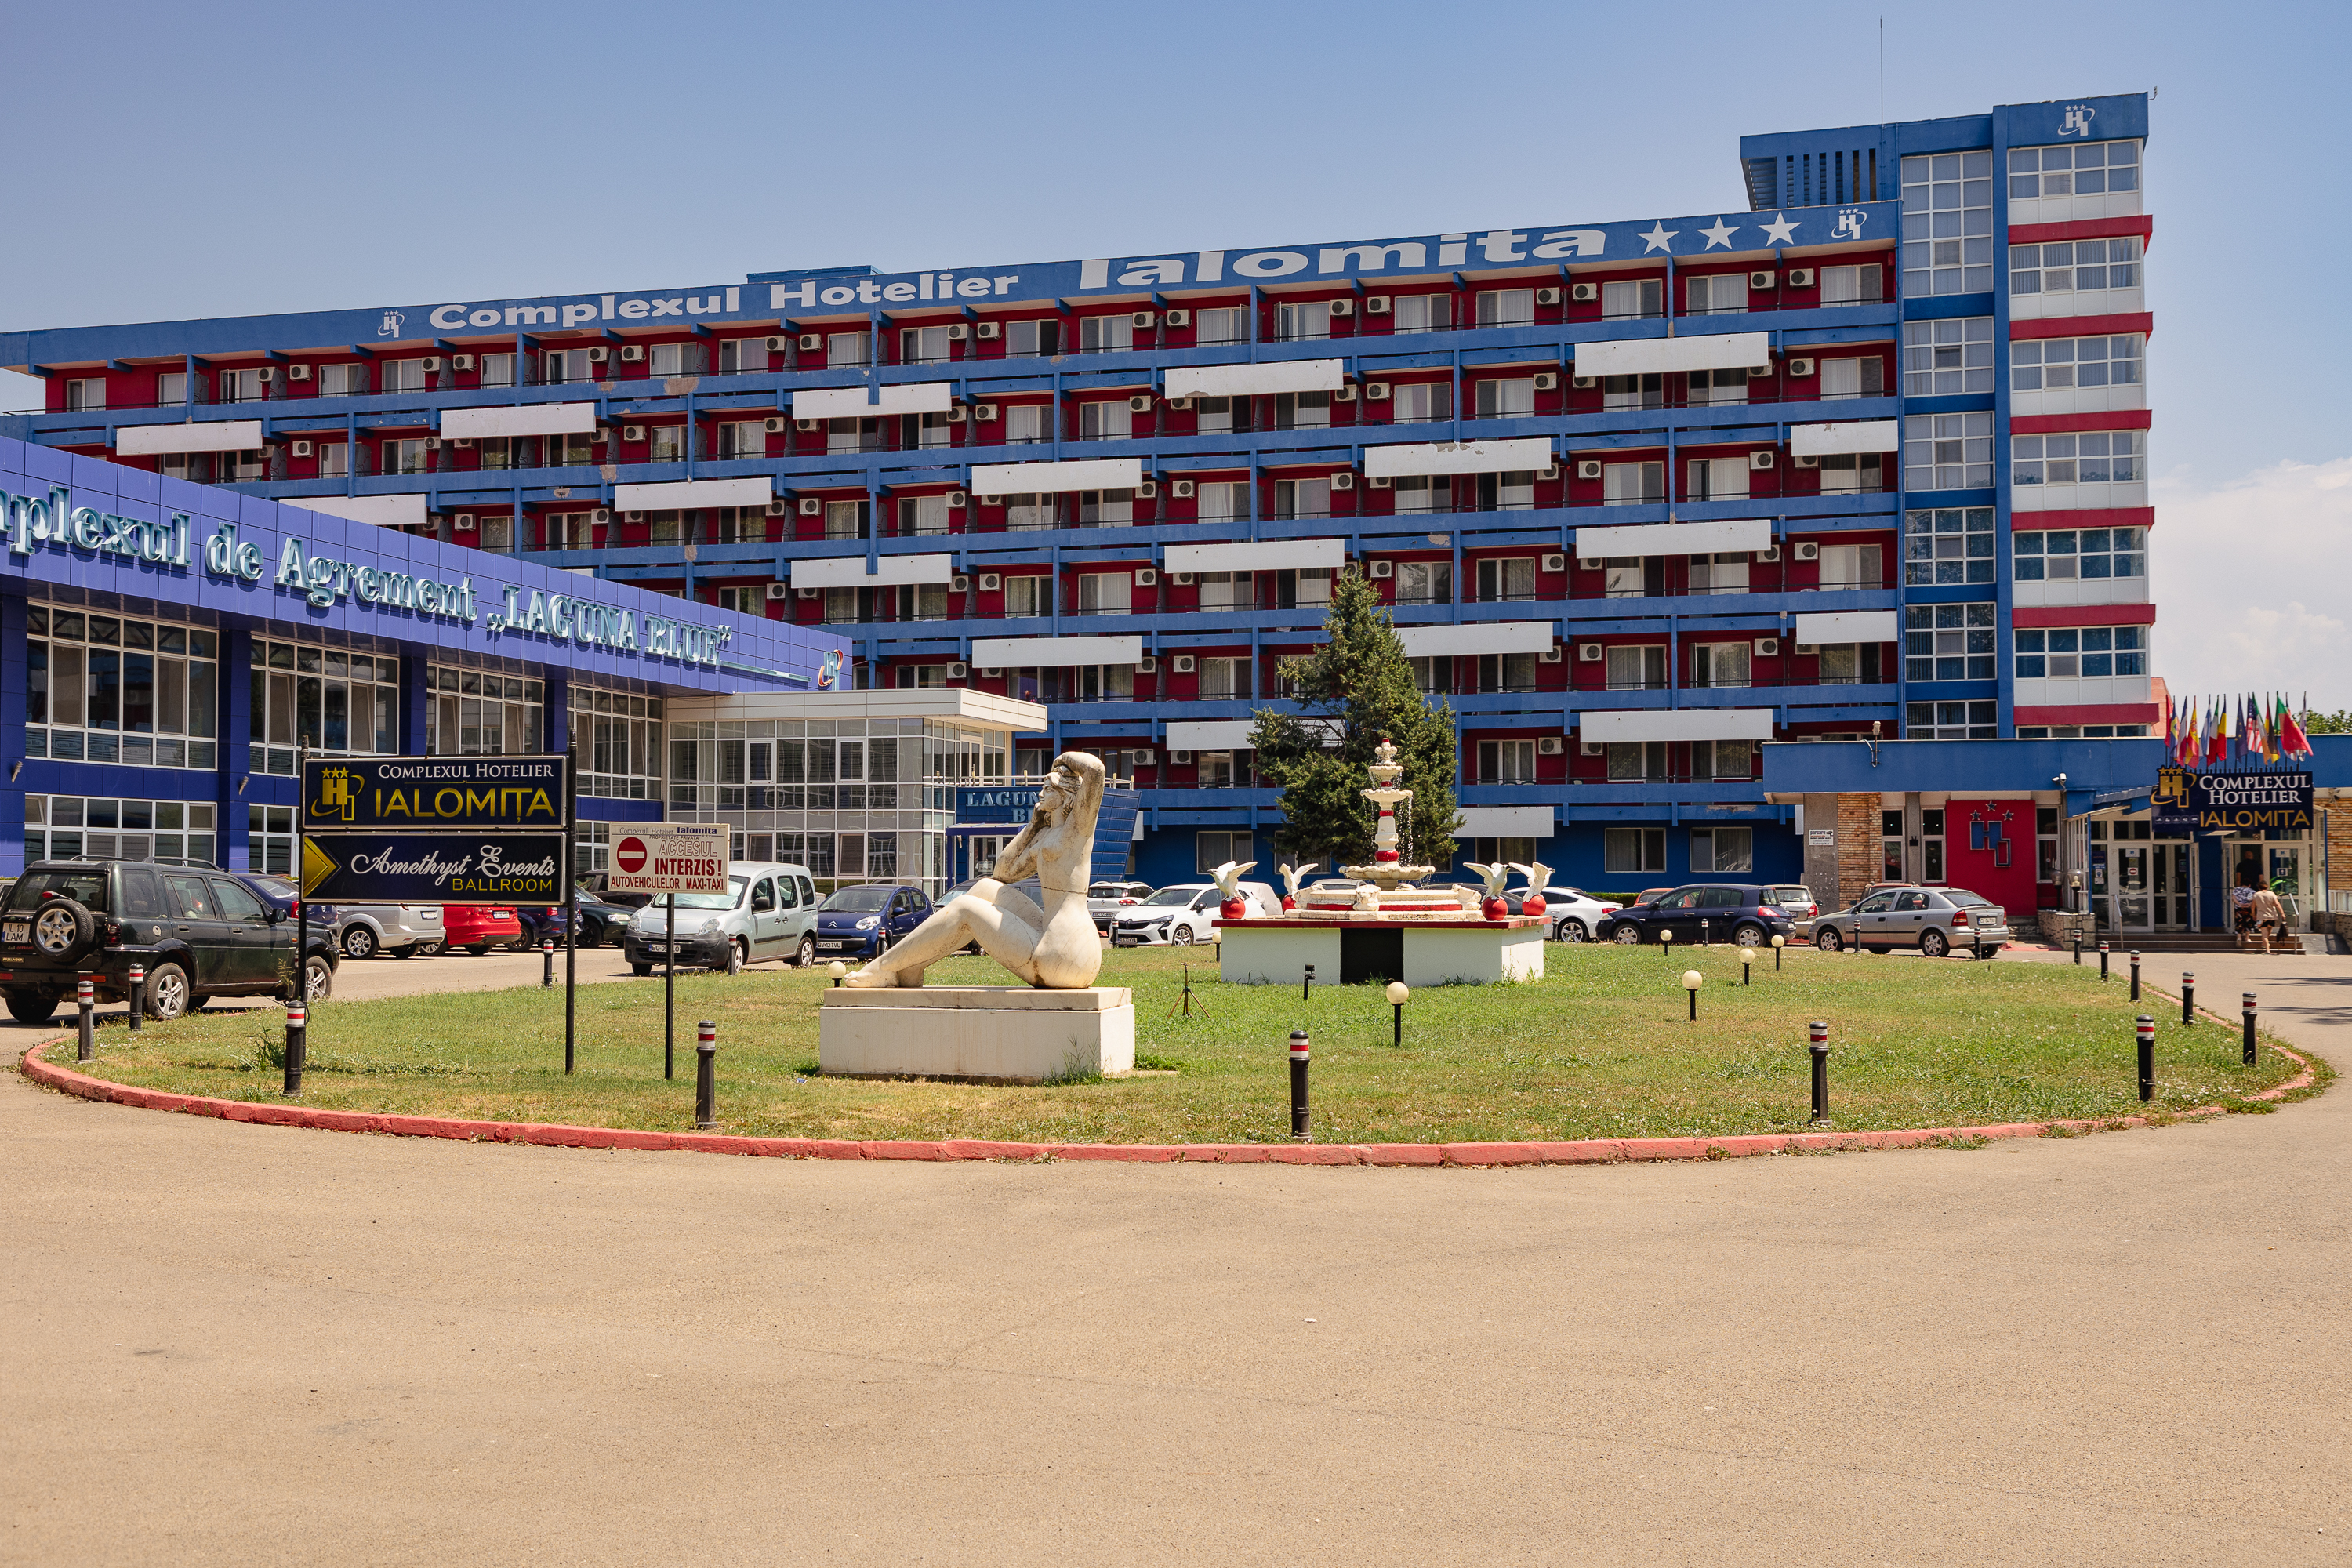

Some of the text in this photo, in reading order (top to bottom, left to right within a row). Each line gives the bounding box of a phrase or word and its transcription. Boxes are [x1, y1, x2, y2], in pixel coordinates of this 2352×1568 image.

[430, 227, 1606, 330] Complexul Hotelier Ialomita
[205, 522, 264, 581] de
[274, 538, 478, 622] Agrement
[379, 764, 554, 779] COMPLEXUL HOTELIER
[2199, 775, 2310, 790] COMPLEXUL
[966, 792, 1040, 807] LAGUN
[2209, 789, 2302, 804] HOTELIER
[376, 787, 555, 823] IALOMIȚA
[620, 827, 648, 836] Compexul
[659, 840, 717, 857] ACCESUL
[351, 844, 555, 885] Amethyst Events
[452, 879, 552, 891] BALLROOM
[611, 876, 724, 890] AUTOVEHICULELOR MAXI-TAXI
